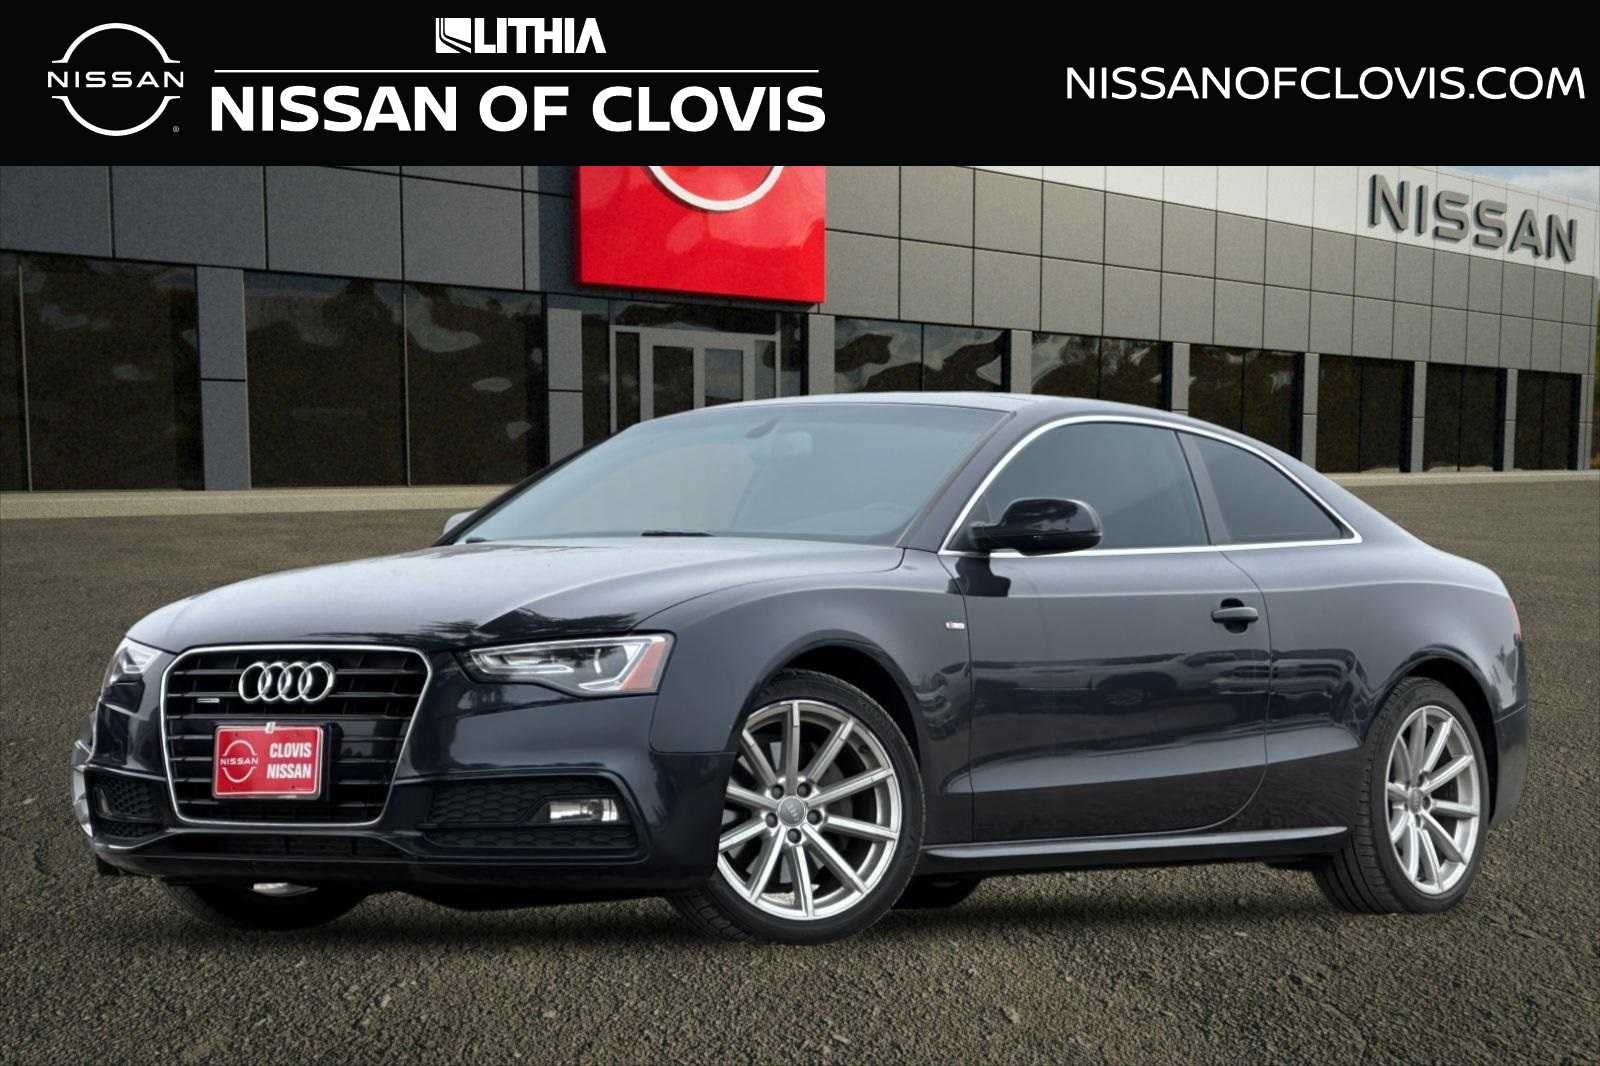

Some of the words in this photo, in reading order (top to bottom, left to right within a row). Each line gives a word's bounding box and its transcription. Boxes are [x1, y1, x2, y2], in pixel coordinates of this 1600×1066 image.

[1368, 174, 1578, 263] NISSAN
[270, 743, 312, 758] CLOVIS
[220, 758, 258, 766] NISSAN
[267, 764, 312, 779] NISSAN
